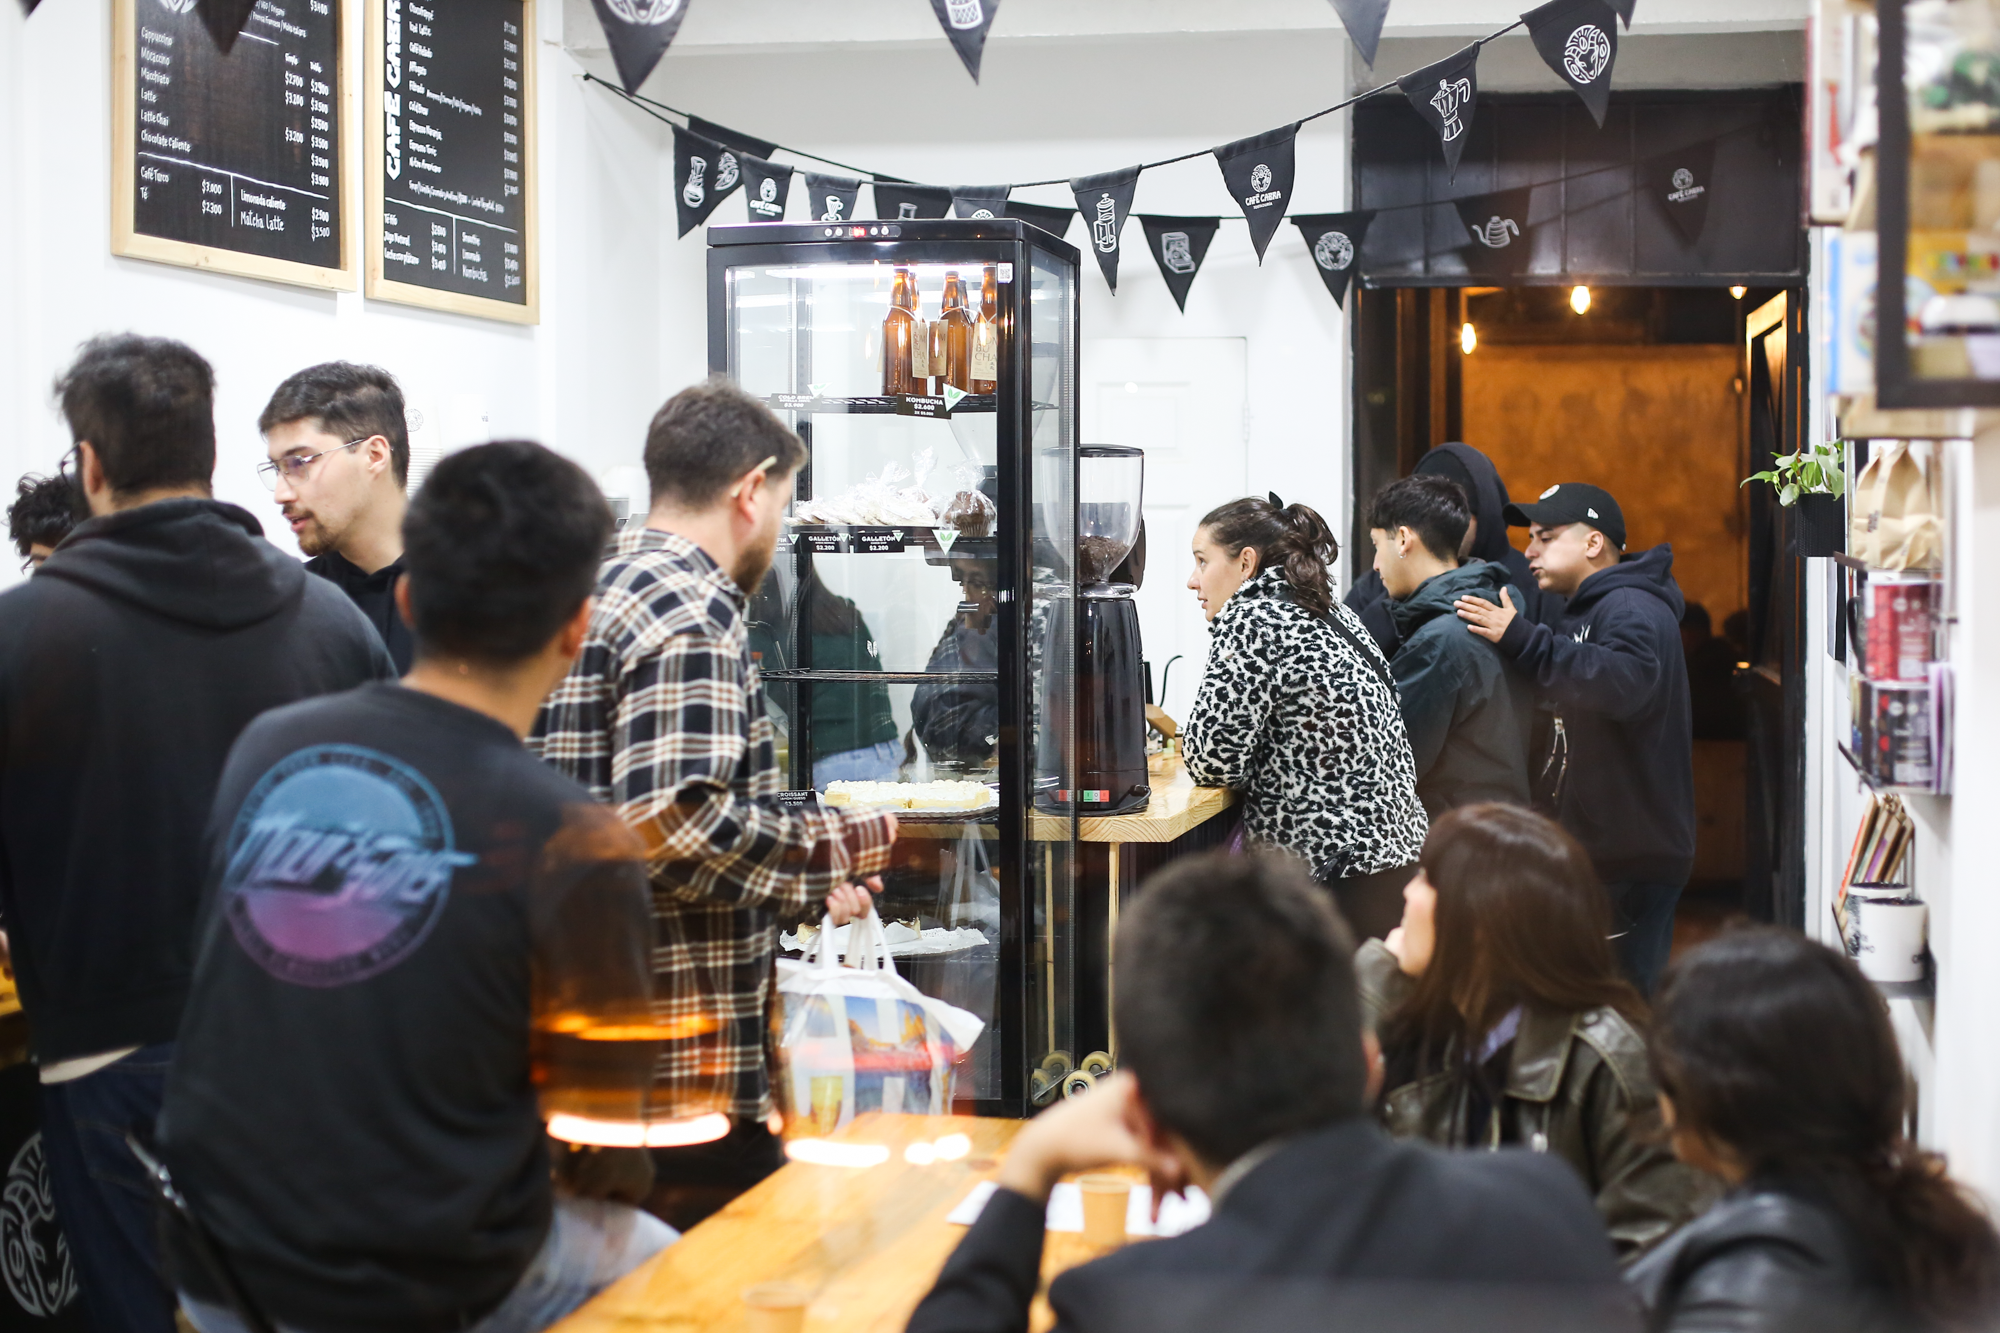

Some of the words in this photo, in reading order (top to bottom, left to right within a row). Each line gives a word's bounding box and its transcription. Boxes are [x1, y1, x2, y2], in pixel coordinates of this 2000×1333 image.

[141, 27, 172, 46] Cappuccino
[141, 47, 170, 66] Mocaccino
[141, 67, 169, 85] Macchiato
[141, 88, 157, 103] Latte
[140, 109, 156, 121] Latte
[155, 112, 169, 126] Chai
[141, 130, 168, 147] Chocolate
[168, 137, 191, 152] Caliente
[140, 166, 154, 180] Café
[154, 169, 169, 183] Turco
[140, 187, 148, 200] Té
[241, 189, 266, 207] Limonada
[266, 196, 286, 210] caliente
[1245, 193, 1260, 206] CAFÉ
[1260, 190, 1282, 202] CABRA
[240, 210, 264, 229] Matcha
[906, 397, 943, 405] KOMBUCHA
